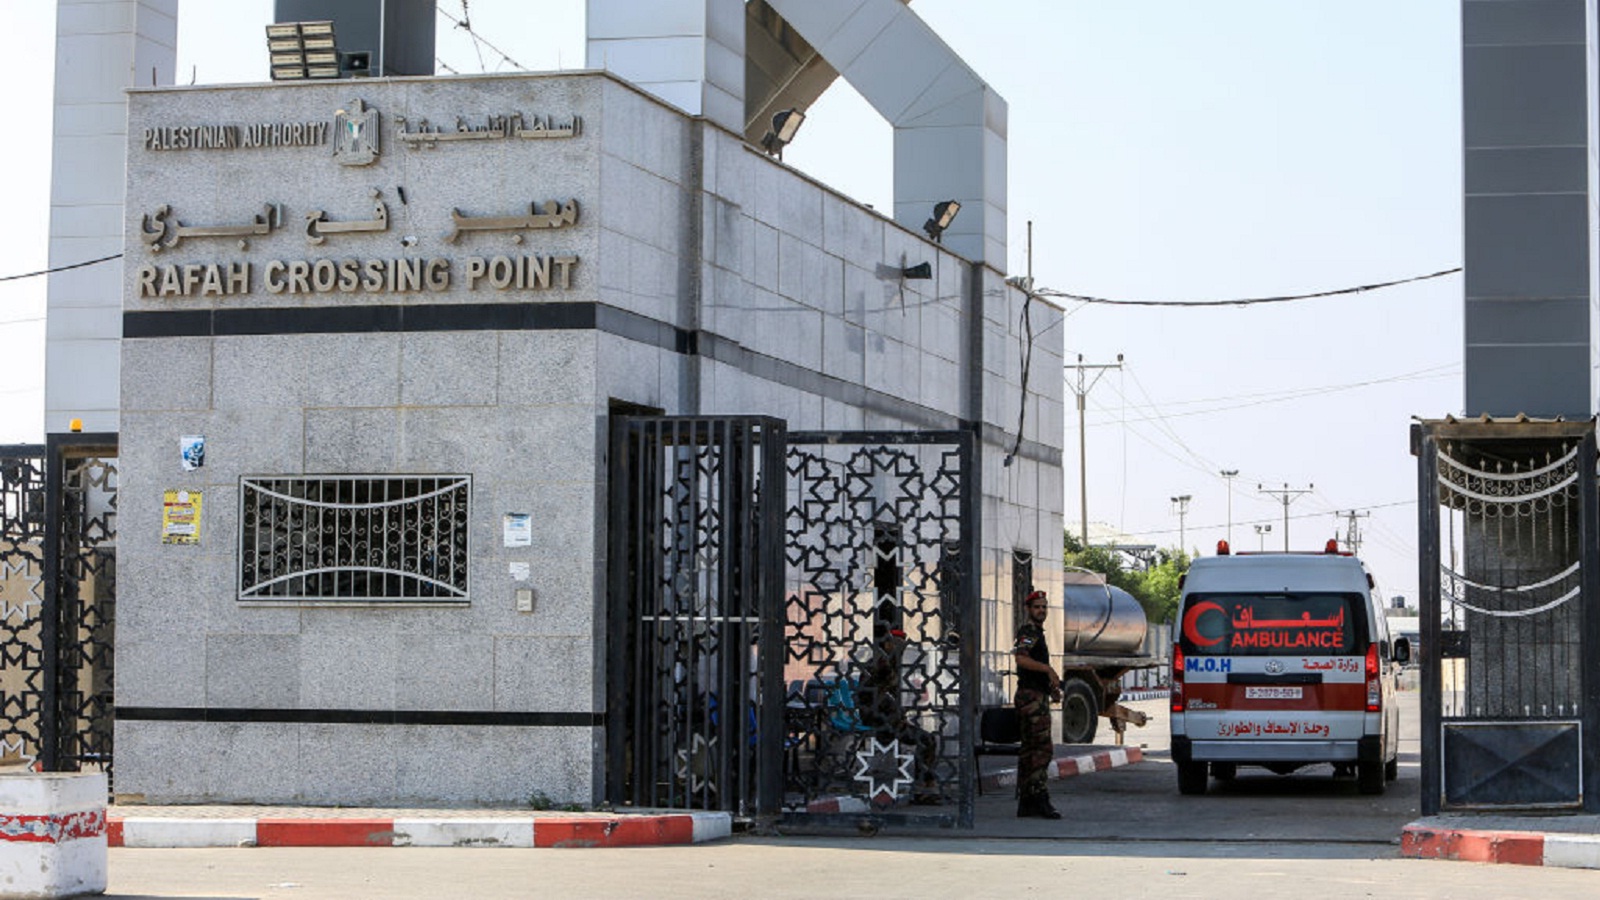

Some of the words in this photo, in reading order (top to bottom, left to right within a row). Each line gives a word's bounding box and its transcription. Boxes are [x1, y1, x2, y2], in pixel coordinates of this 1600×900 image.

[144, 125, 238, 151] PALESTINIAN
[243, 121, 328, 148] AUTHORITY
[513, 111, 582, 140] السلطة
[141, 202, 284, 252] البري
[444, 198, 580, 245] معبر
[138, 261, 251, 298] RAFAH
[264, 256, 451, 294] CROSSING
[466, 254, 578, 290] POINT
[1231, 631, 1344, 648] AMBULANCE
[1187, 658, 1231, 673] M.O.H
[1302, 658, 1336, 671] الصحة
[1338, 658, 1359, 672] وزارة
[1303, 721, 1330, 737] وحدة
